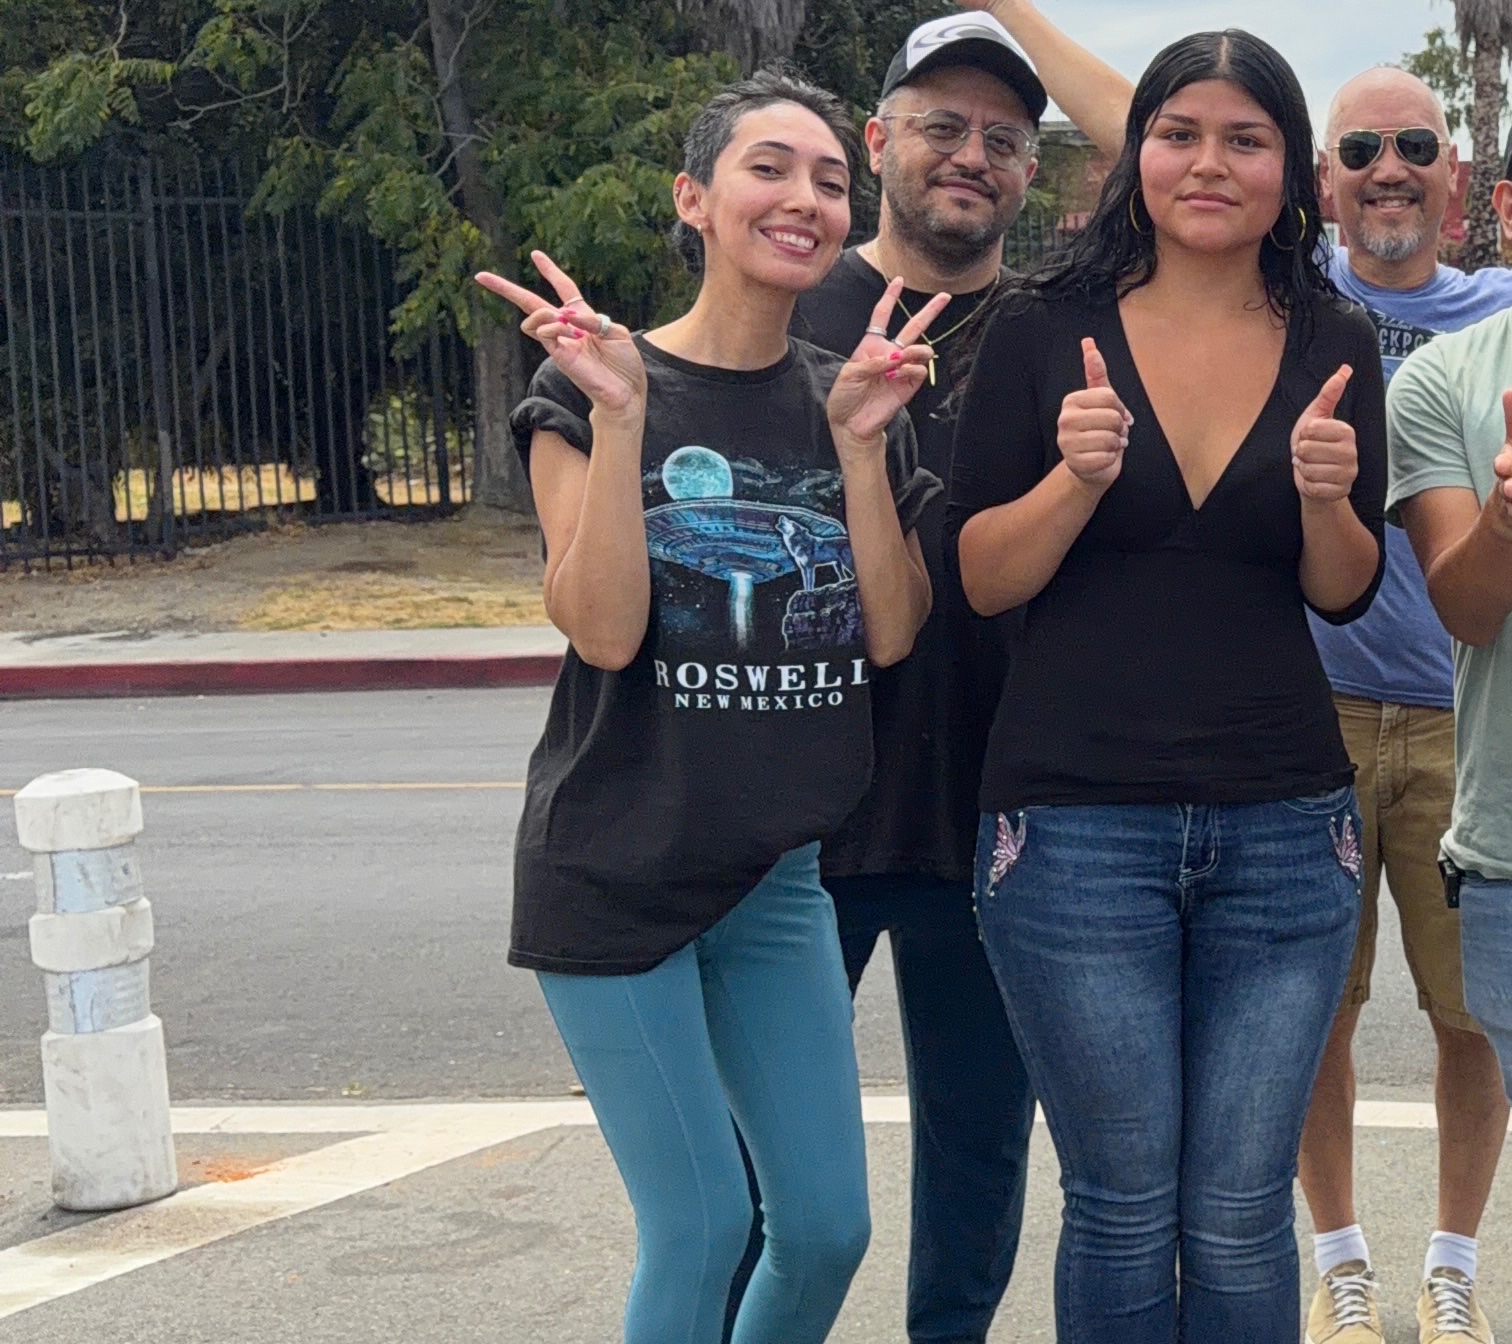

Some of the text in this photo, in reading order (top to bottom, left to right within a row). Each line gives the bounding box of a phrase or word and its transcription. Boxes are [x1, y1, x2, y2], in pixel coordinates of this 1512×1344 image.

[654, 658, 869, 692] ROSWELL
[674, 691, 843, 711] NEW MEXICO
